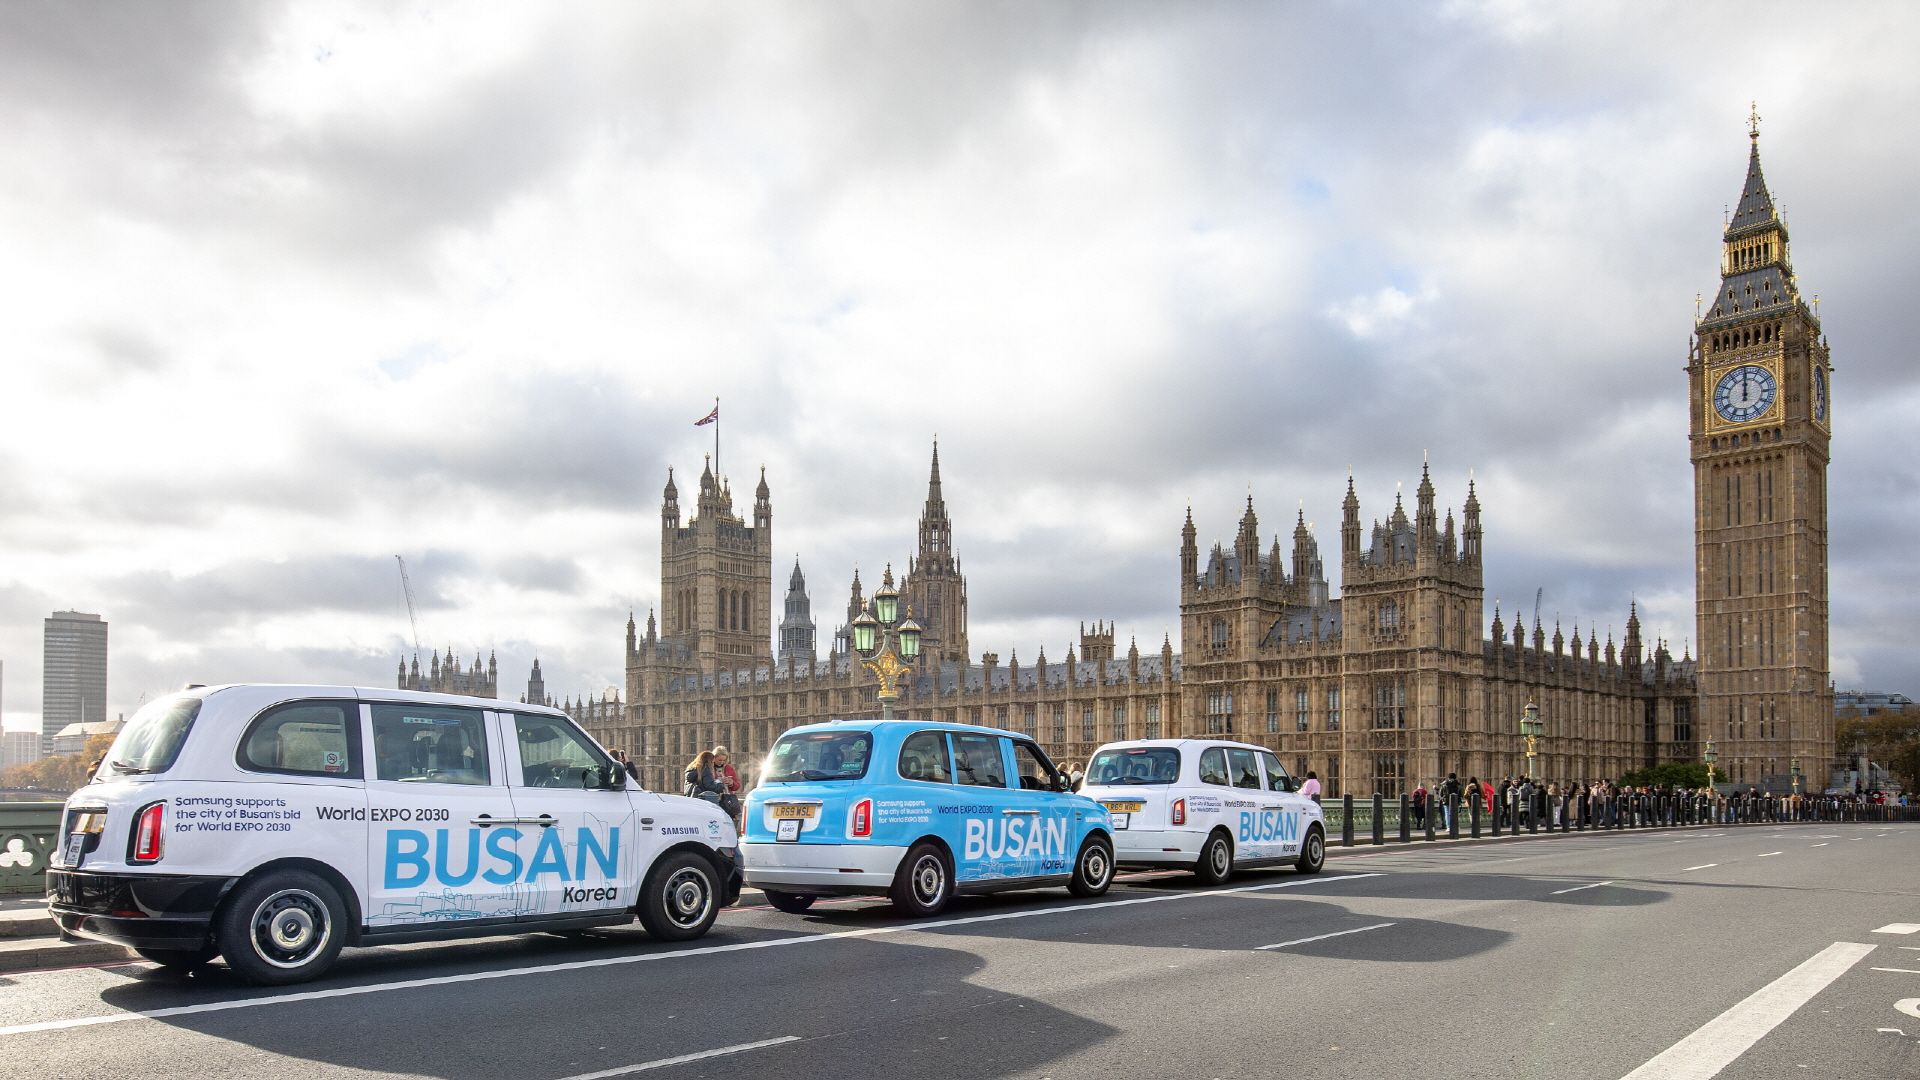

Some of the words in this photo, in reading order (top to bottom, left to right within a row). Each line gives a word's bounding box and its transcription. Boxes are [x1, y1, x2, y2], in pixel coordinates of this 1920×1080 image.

[175, 797, 233, 808] Samsung
[235, 798, 286, 809] supports
[175, 809, 197, 819] the
[200, 808, 222, 821] city
[225, 809, 237, 819] of
[240, 809, 281, 819] Busan's
[283, 810, 301, 820] bid
[316, 806, 366, 821] World
[371, 808, 412, 821] EXPO
[415, 808, 450, 821] 2030
[938, 805, 959, 814] World
[960, 805, 977, 814] EXPO
[978, 805, 994, 814] 2030
[175, 822, 193, 833] for
[197, 822, 232, 832] World
[234, 823, 263, 832] EXPO
[266, 822, 291, 832] 2030
[661, 826, 700, 836] SAMSUNG
[1239, 811, 1298, 842] BUSAN
[965, 817, 1067, 860] BUSAN
[1282, 844, 1297, 852] Korea
[384, 826, 620, 889] BUSAN
[1040, 859, 1065, 870] Korea
[562, 886, 618, 903] Korea
